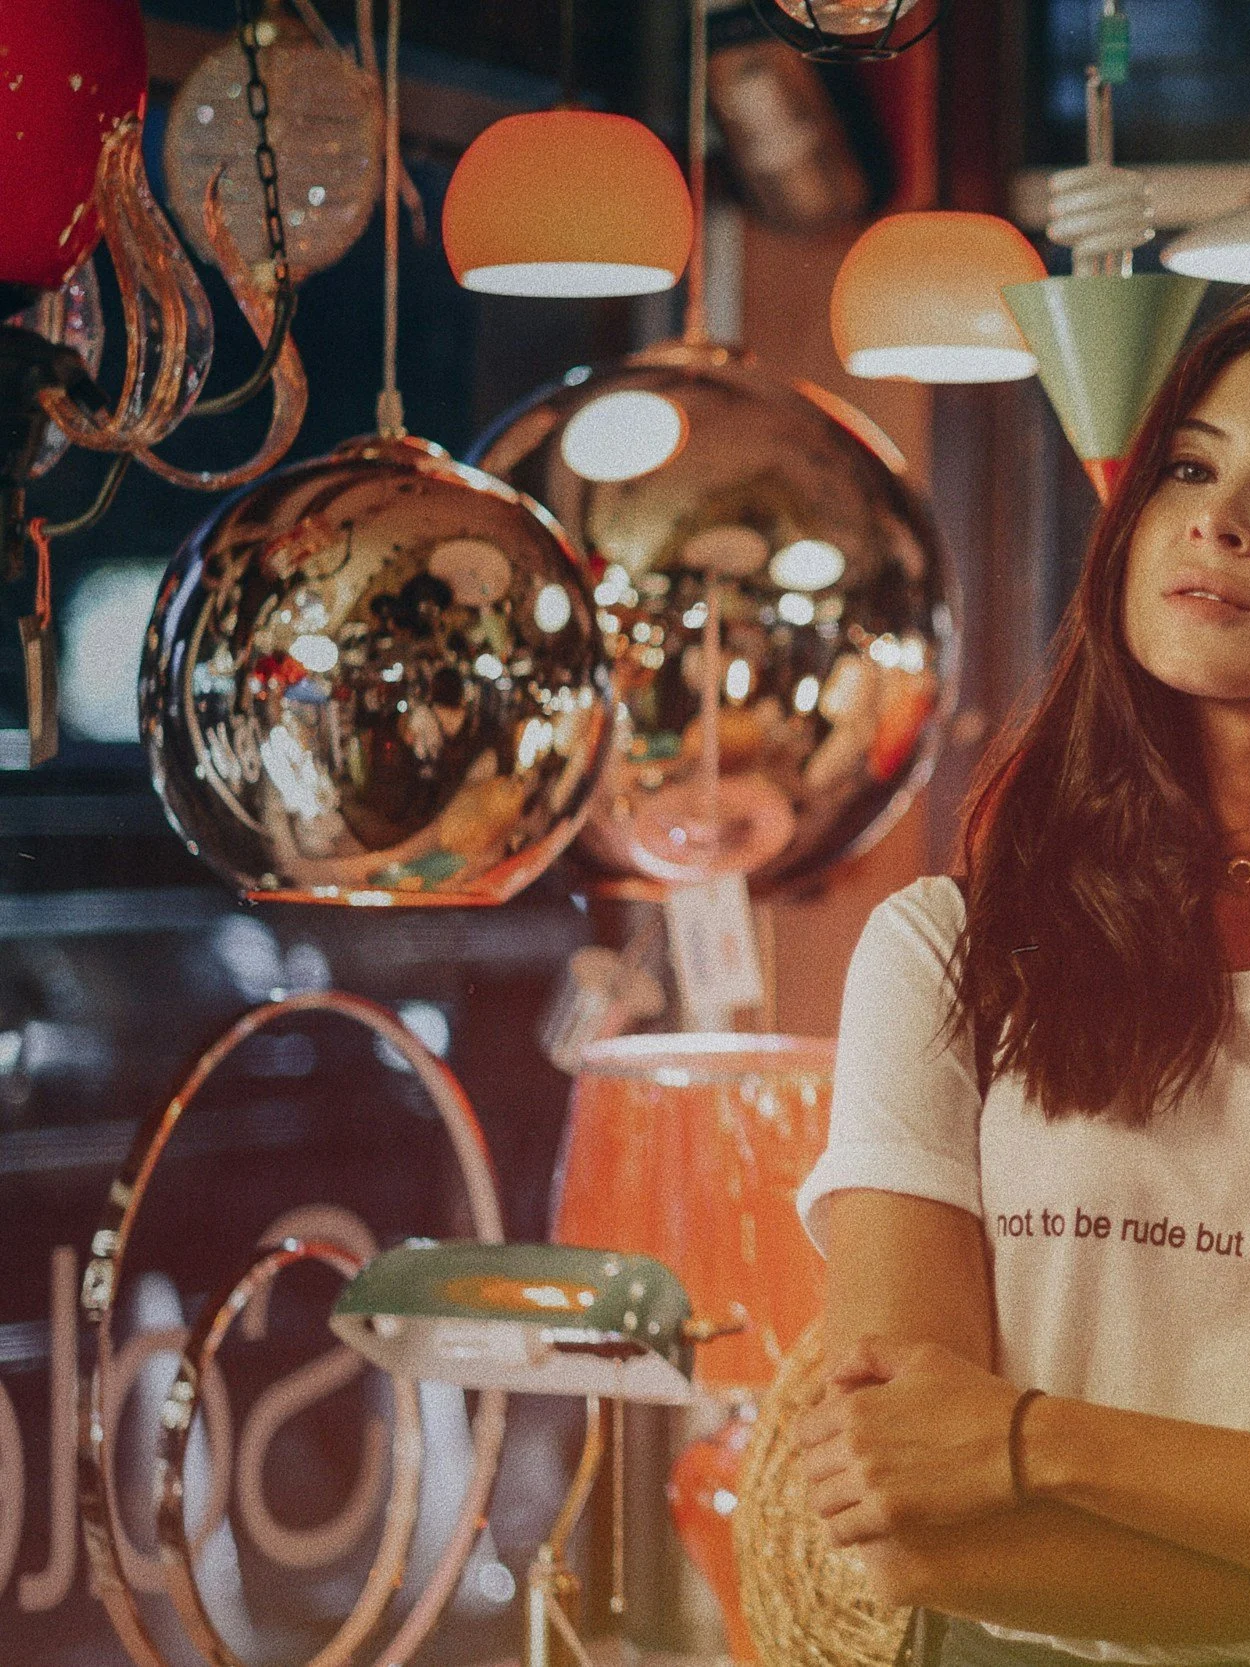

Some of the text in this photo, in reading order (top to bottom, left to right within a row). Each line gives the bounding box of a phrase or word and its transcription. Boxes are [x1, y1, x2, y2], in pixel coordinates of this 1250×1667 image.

[997, 1208, 1033, 1237] not
[1041, 1208, 1065, 1237] to
[1075, 1206, 1112, 1239] be
[1121, 1216, 1186, 1248] rude
[1196, 1222, 1244, 1257] but
